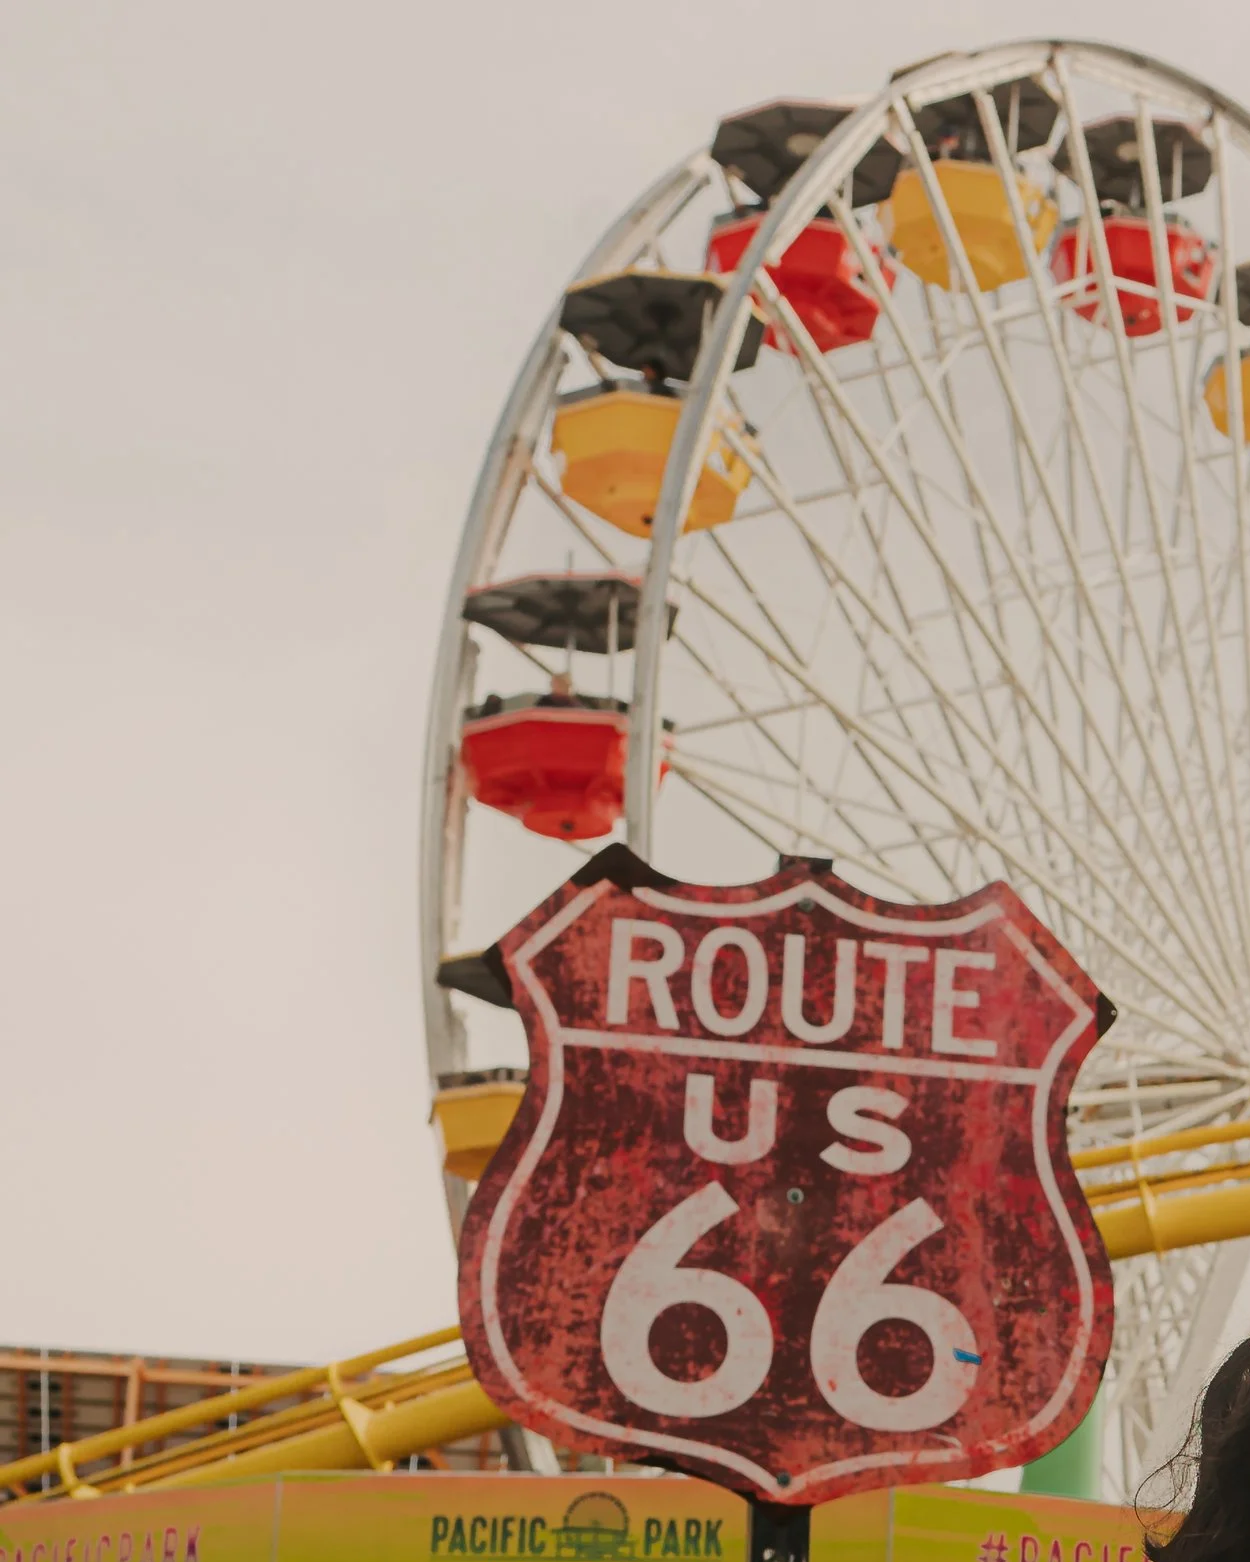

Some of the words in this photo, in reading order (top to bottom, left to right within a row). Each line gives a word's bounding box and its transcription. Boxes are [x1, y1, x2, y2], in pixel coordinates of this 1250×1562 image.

[606, 918, 997, 1058] ROUTE
[601, 1180, 979, 1432] 66
[430, 1515, 548, 1555] PACIFIC
[643, 1517, 723, 1557] PARK
